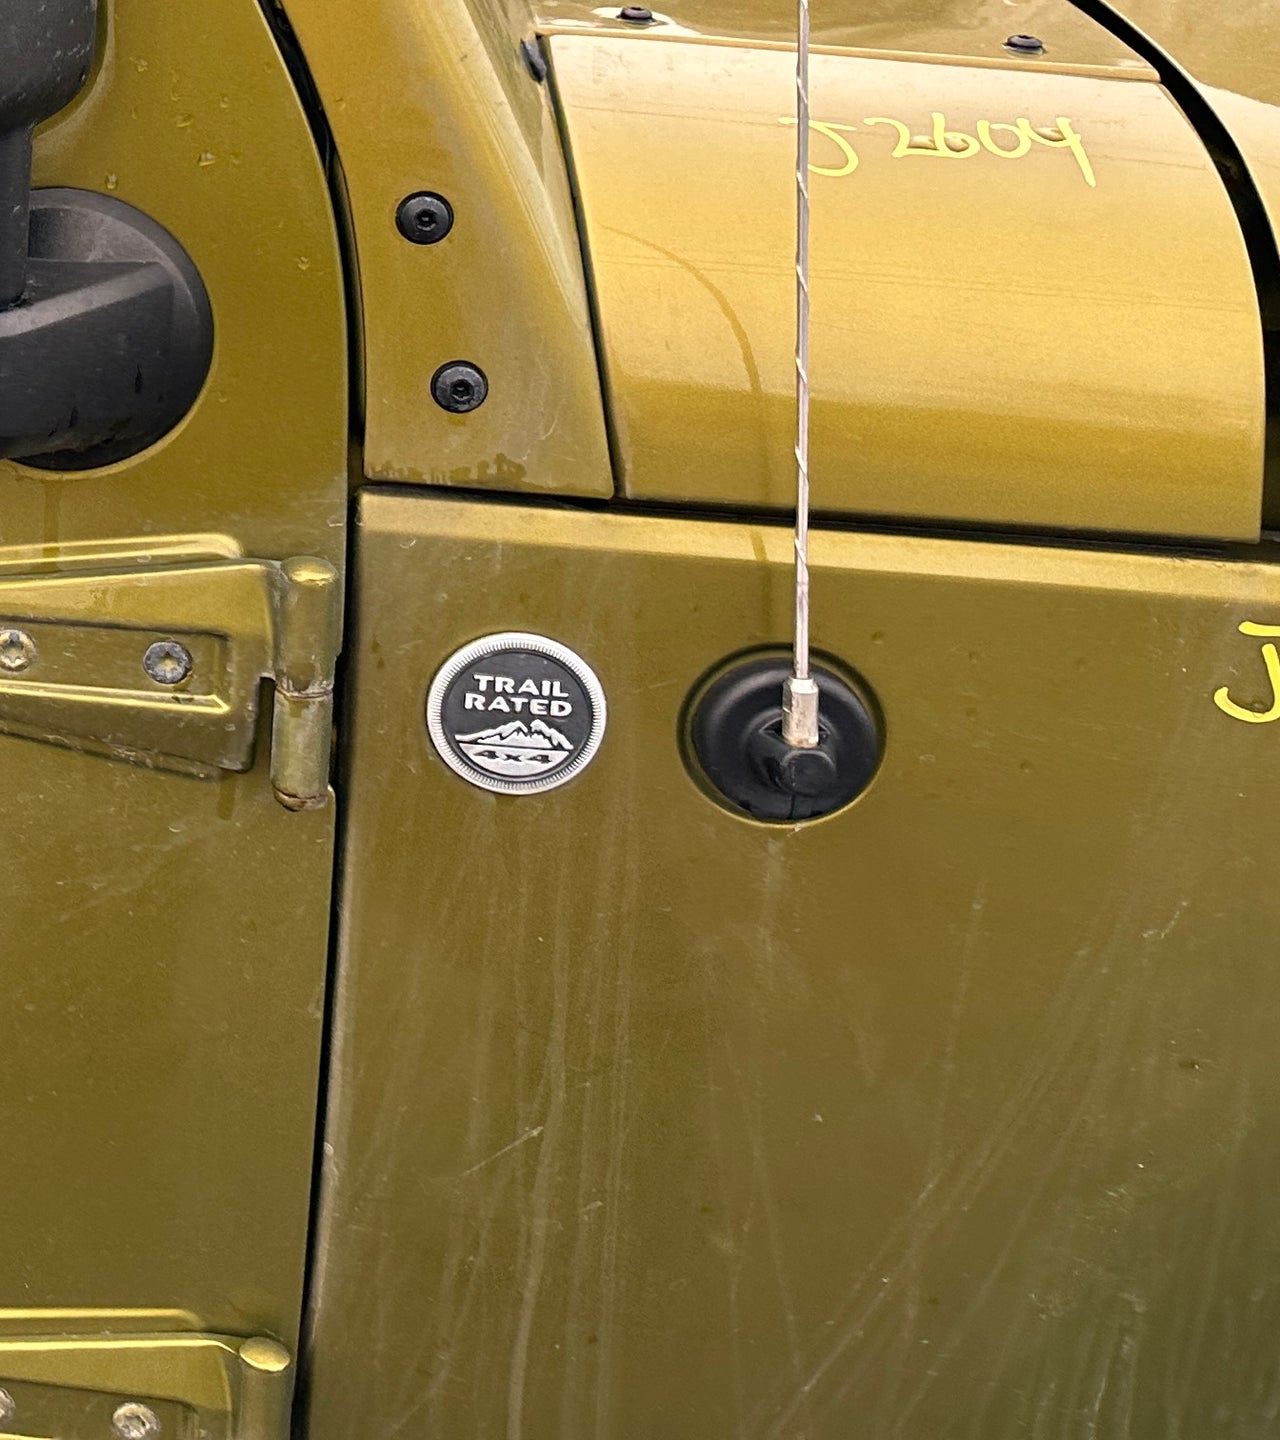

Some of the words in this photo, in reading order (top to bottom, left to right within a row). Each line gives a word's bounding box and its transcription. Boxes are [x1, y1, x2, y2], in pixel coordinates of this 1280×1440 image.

[777, 111, 1097, 188] J2604
[472, 673, 569, 698] TRAIL
[463, 692, 573, 717] RATED
